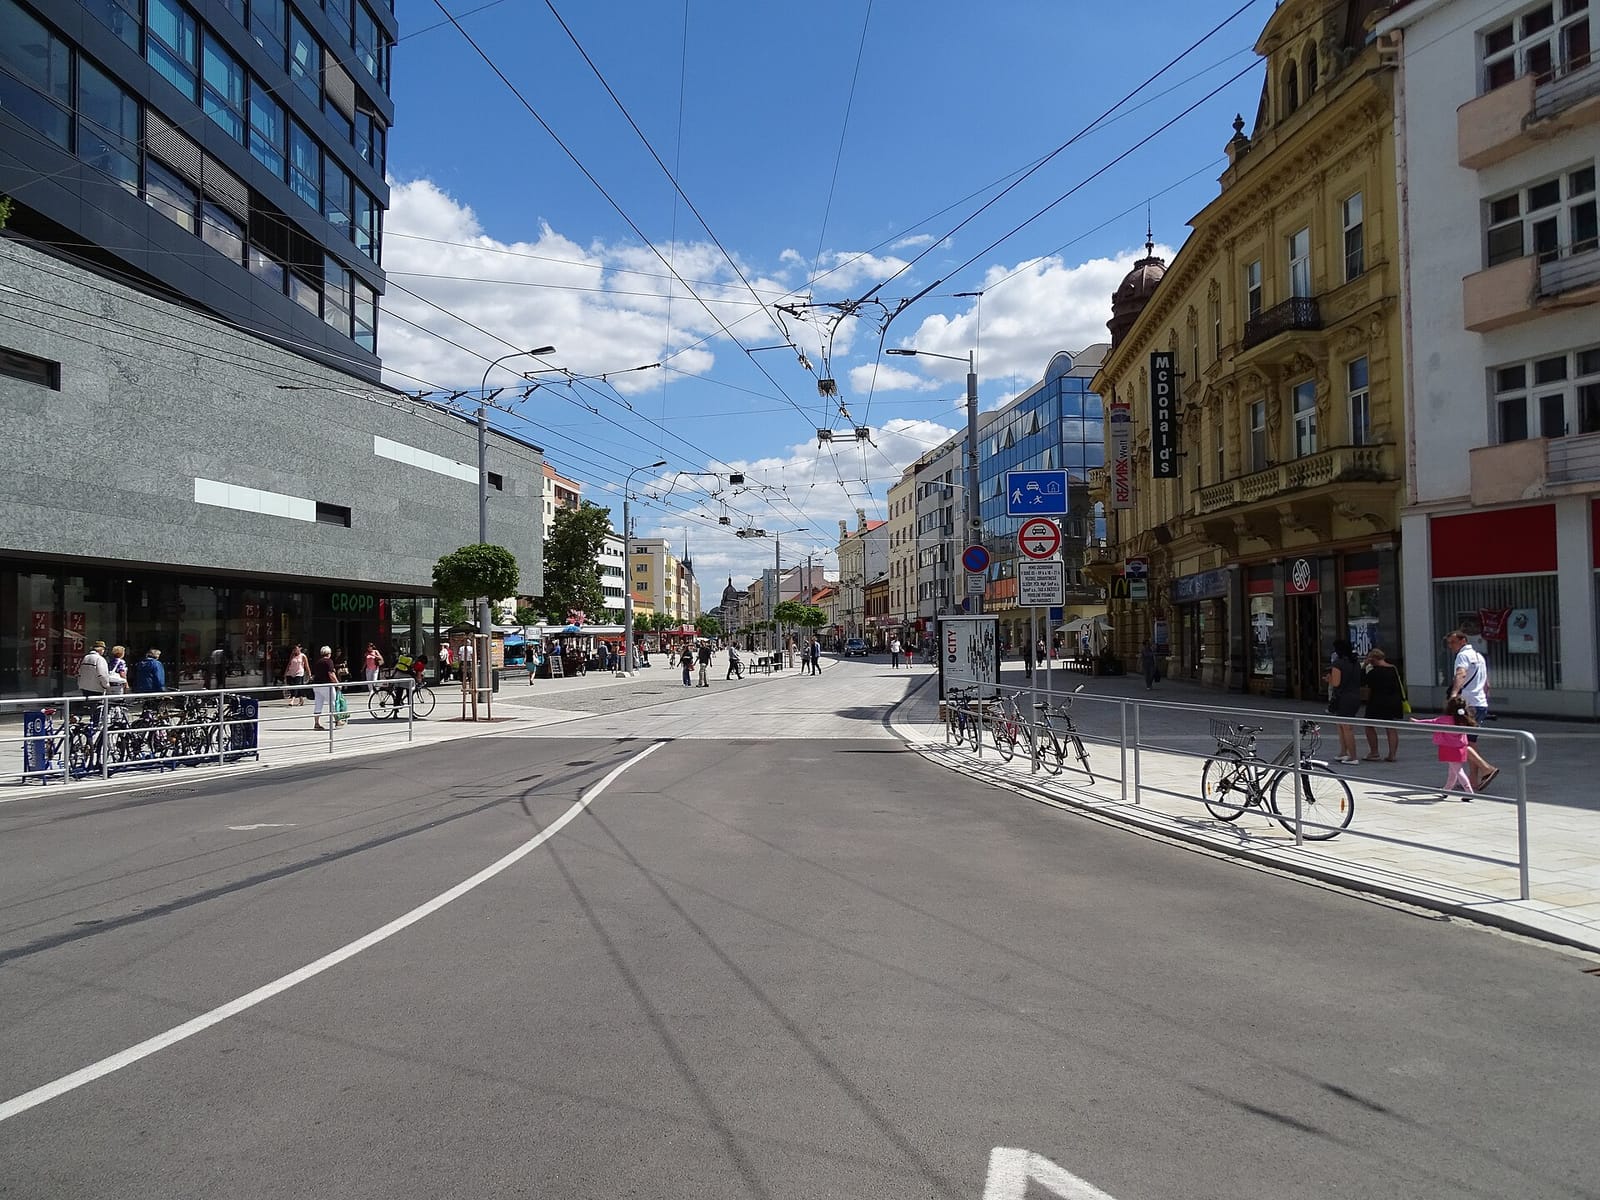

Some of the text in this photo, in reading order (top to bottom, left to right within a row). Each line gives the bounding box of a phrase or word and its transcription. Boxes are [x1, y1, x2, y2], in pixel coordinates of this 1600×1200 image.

[1156, 356, 1173, 473] McDonald's
[1115, 458, 1128, 502] RE/MAX
[332, 593, 374, 612] CROPP
[34, 637, 47, 651] 75
